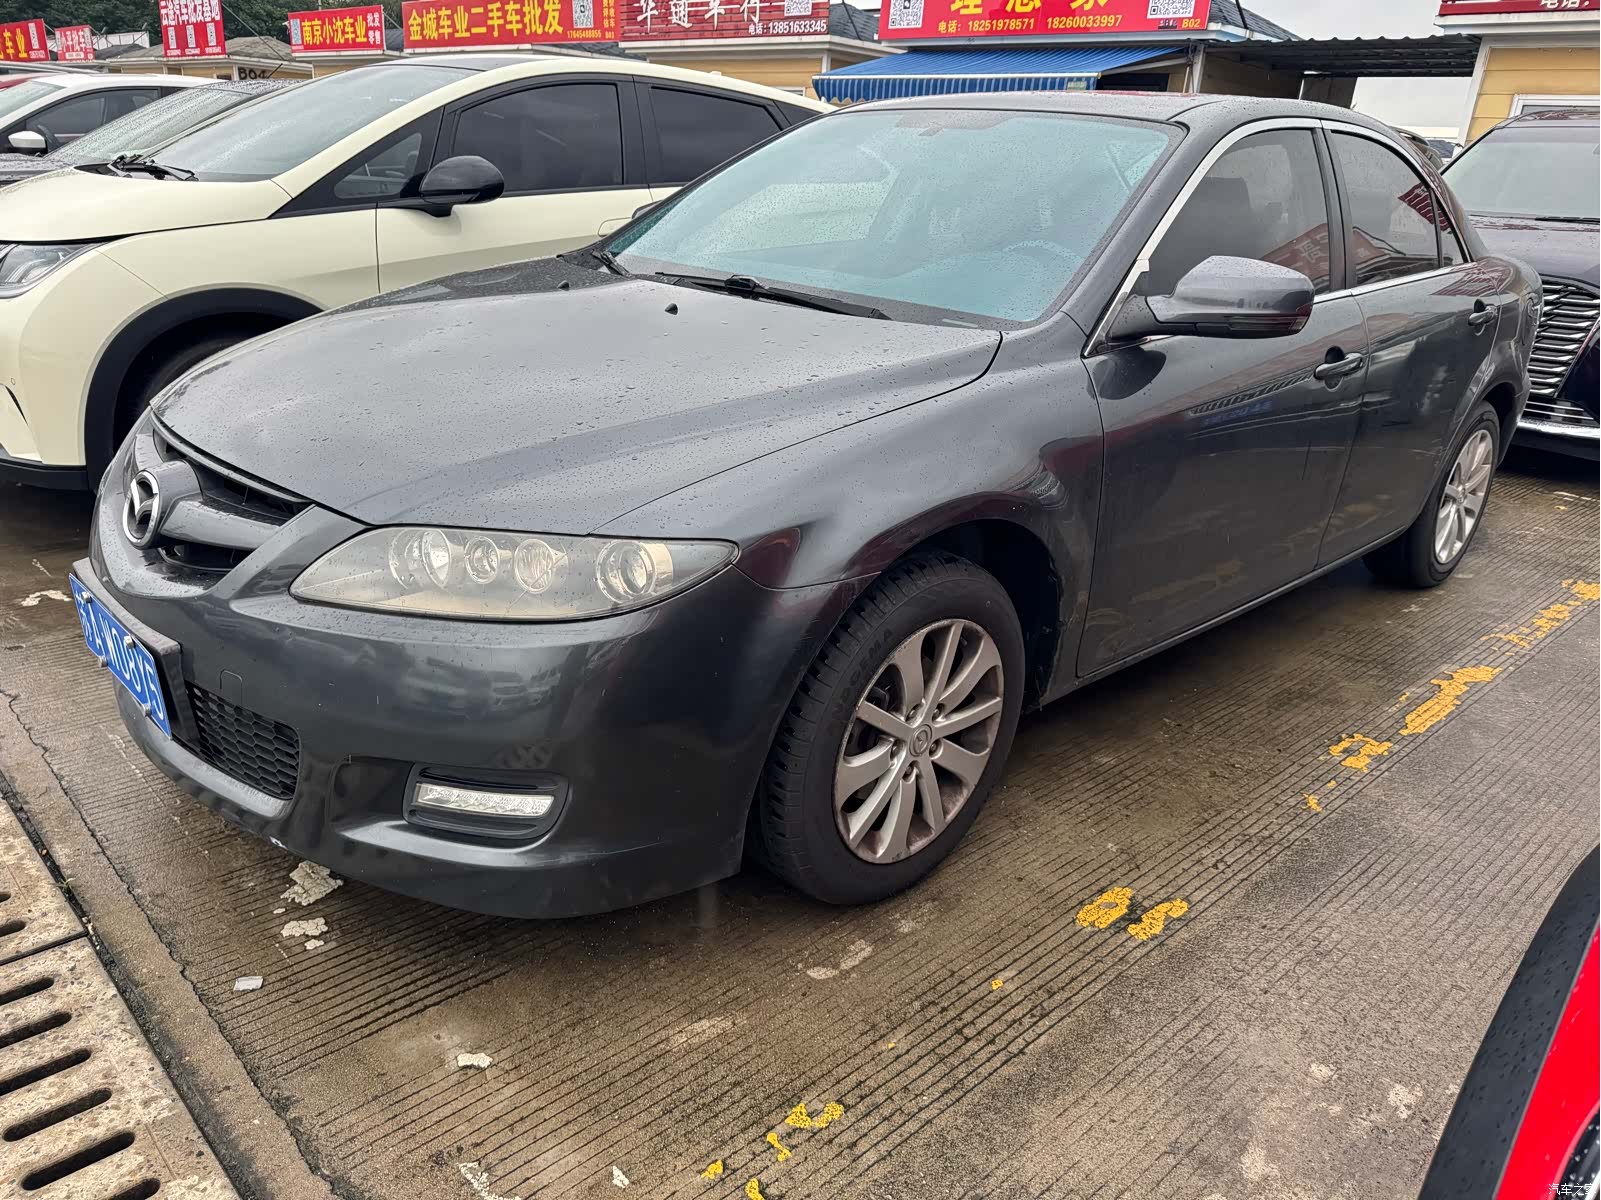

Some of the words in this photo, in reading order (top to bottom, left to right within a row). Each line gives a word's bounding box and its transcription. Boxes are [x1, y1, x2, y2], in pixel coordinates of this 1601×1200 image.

[302, 14, 367, 45] 南京小沈车业
[408, 0, 563, 40] 金城车业二手车批发
[968, 17, 1034, 32] 18251978571
[1047, 14, 1122, 29] 18260033997
[1181, 18, 1201, 29] B02
